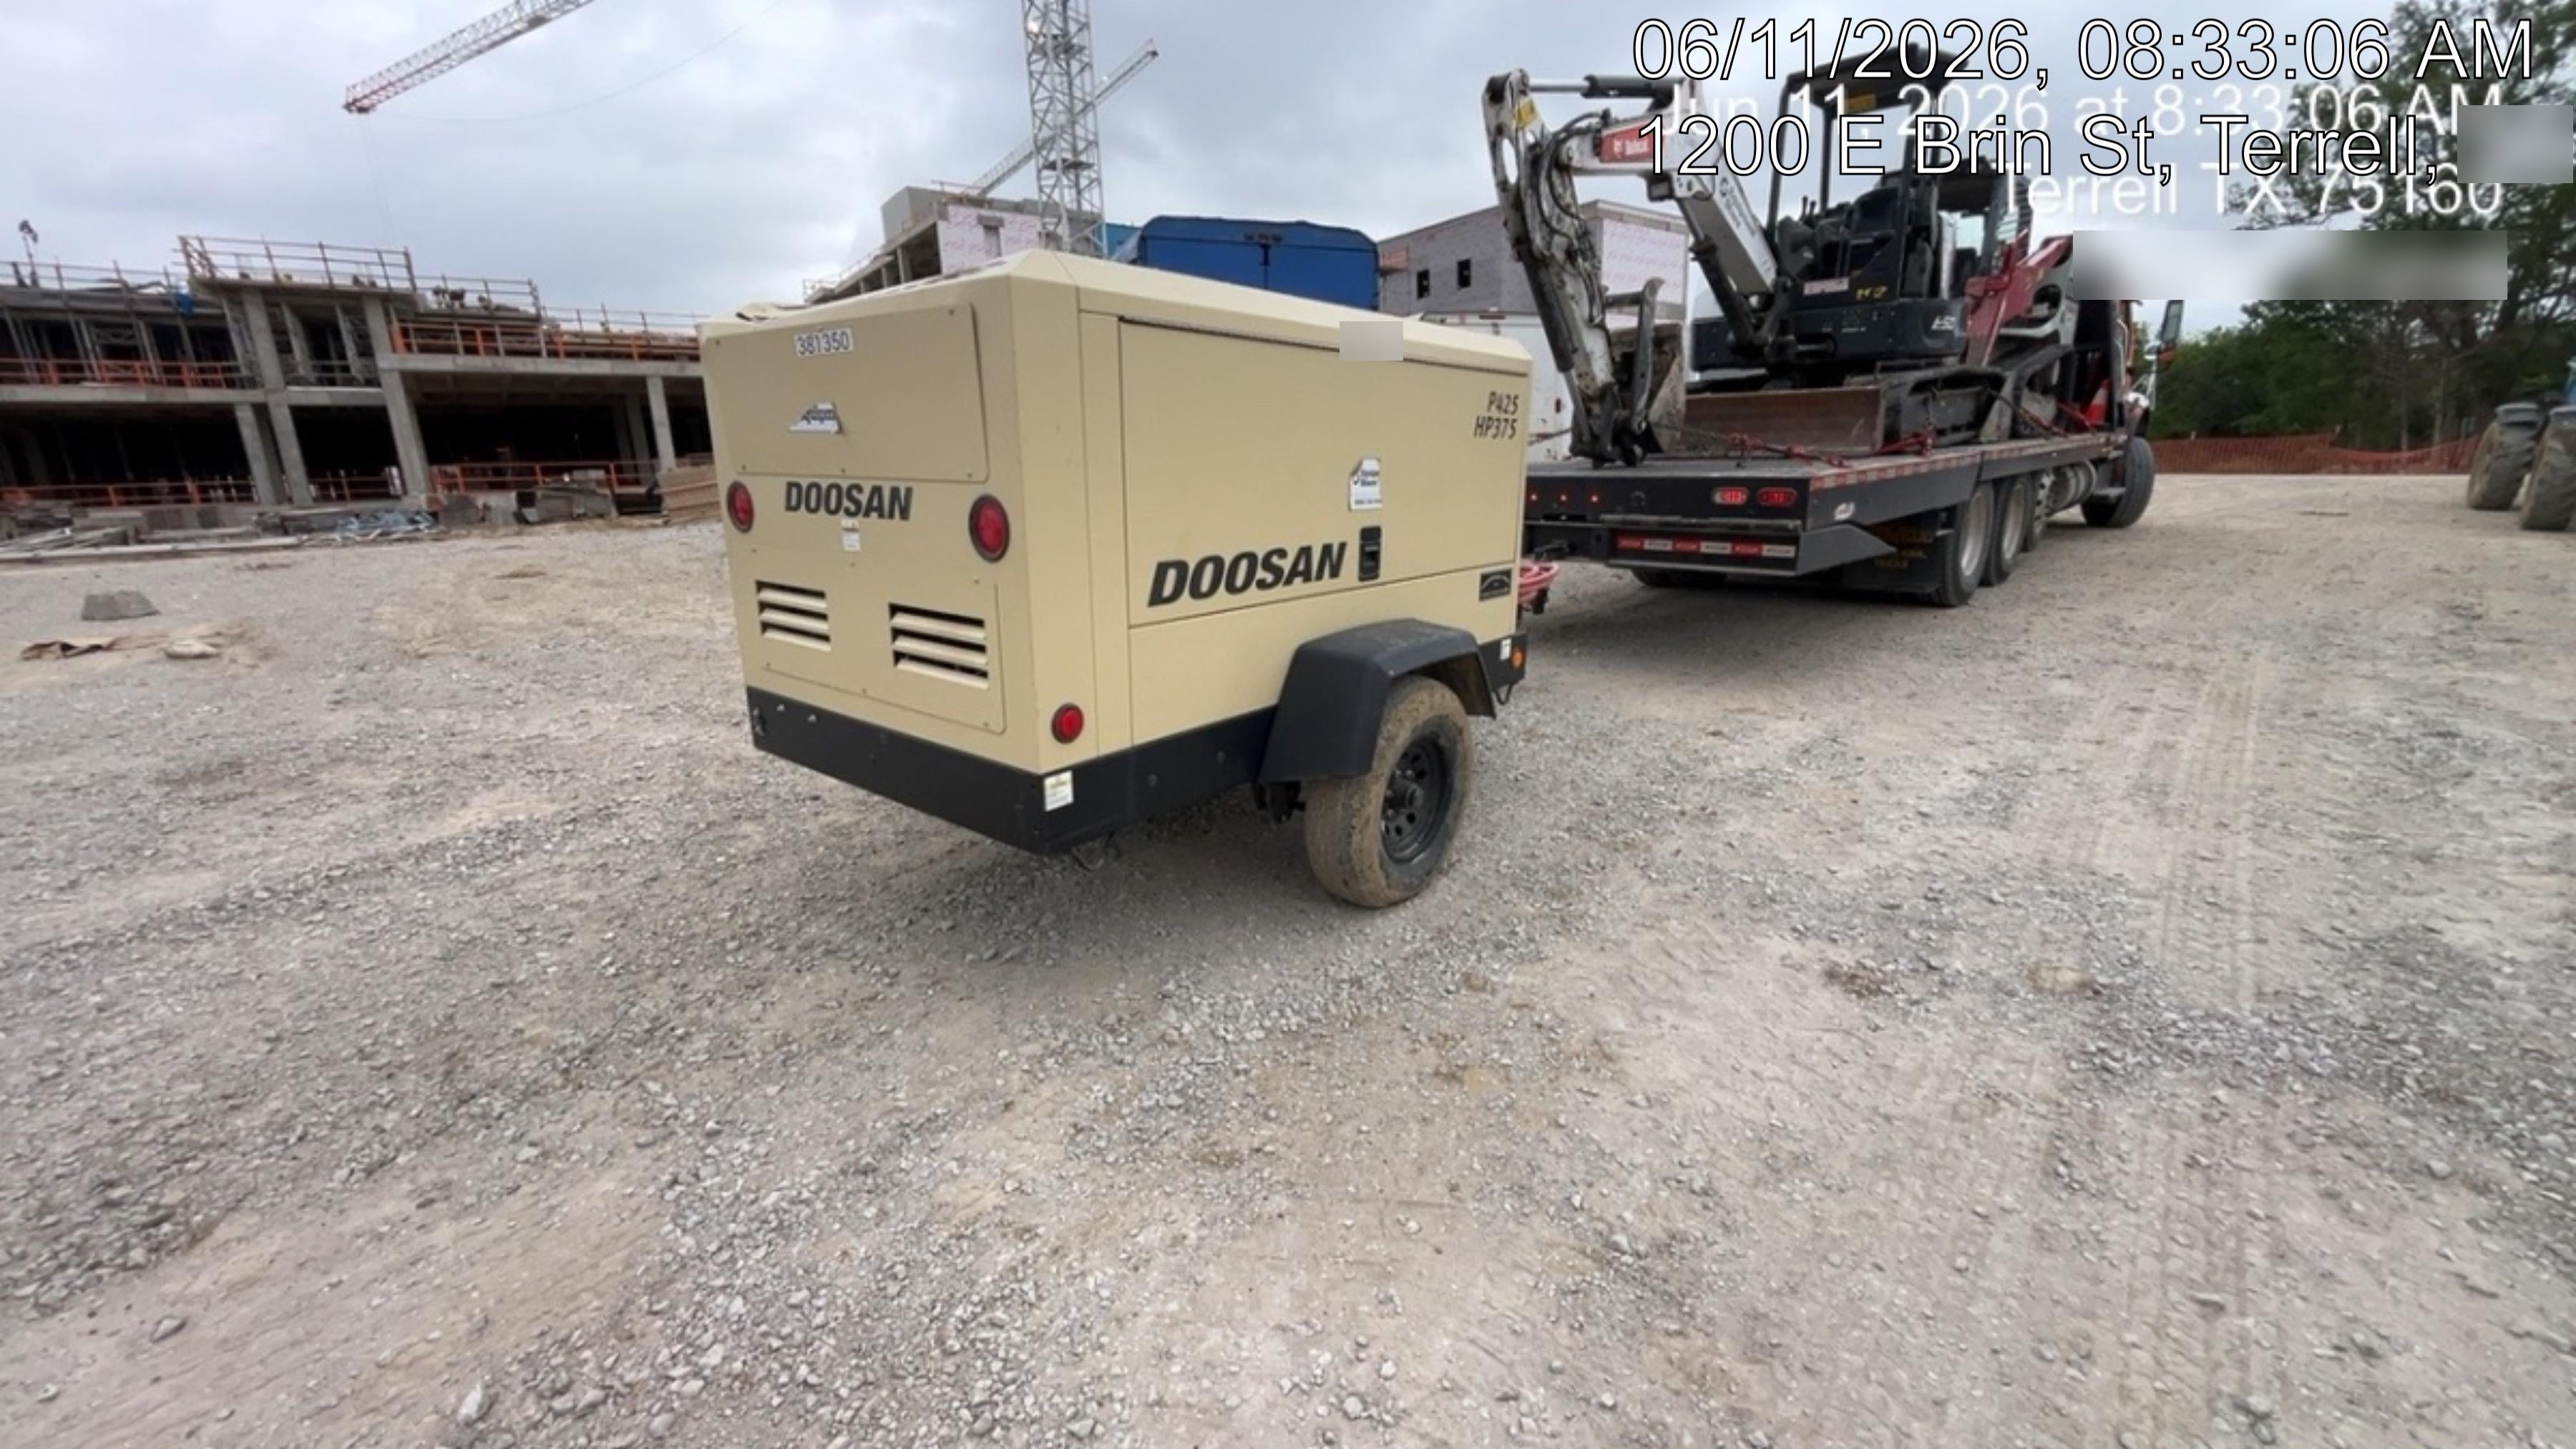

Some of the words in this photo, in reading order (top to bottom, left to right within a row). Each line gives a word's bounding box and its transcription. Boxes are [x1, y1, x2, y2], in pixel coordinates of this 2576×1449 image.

[797, 331, 849, 355] 381350
[1487, 391, 1518, 415] P425
[1474, 416, 1518, 439] HP375
[786, 481, 913, 521] DOOSAN
[1146, 541, 1347, 608] DOOSAN
